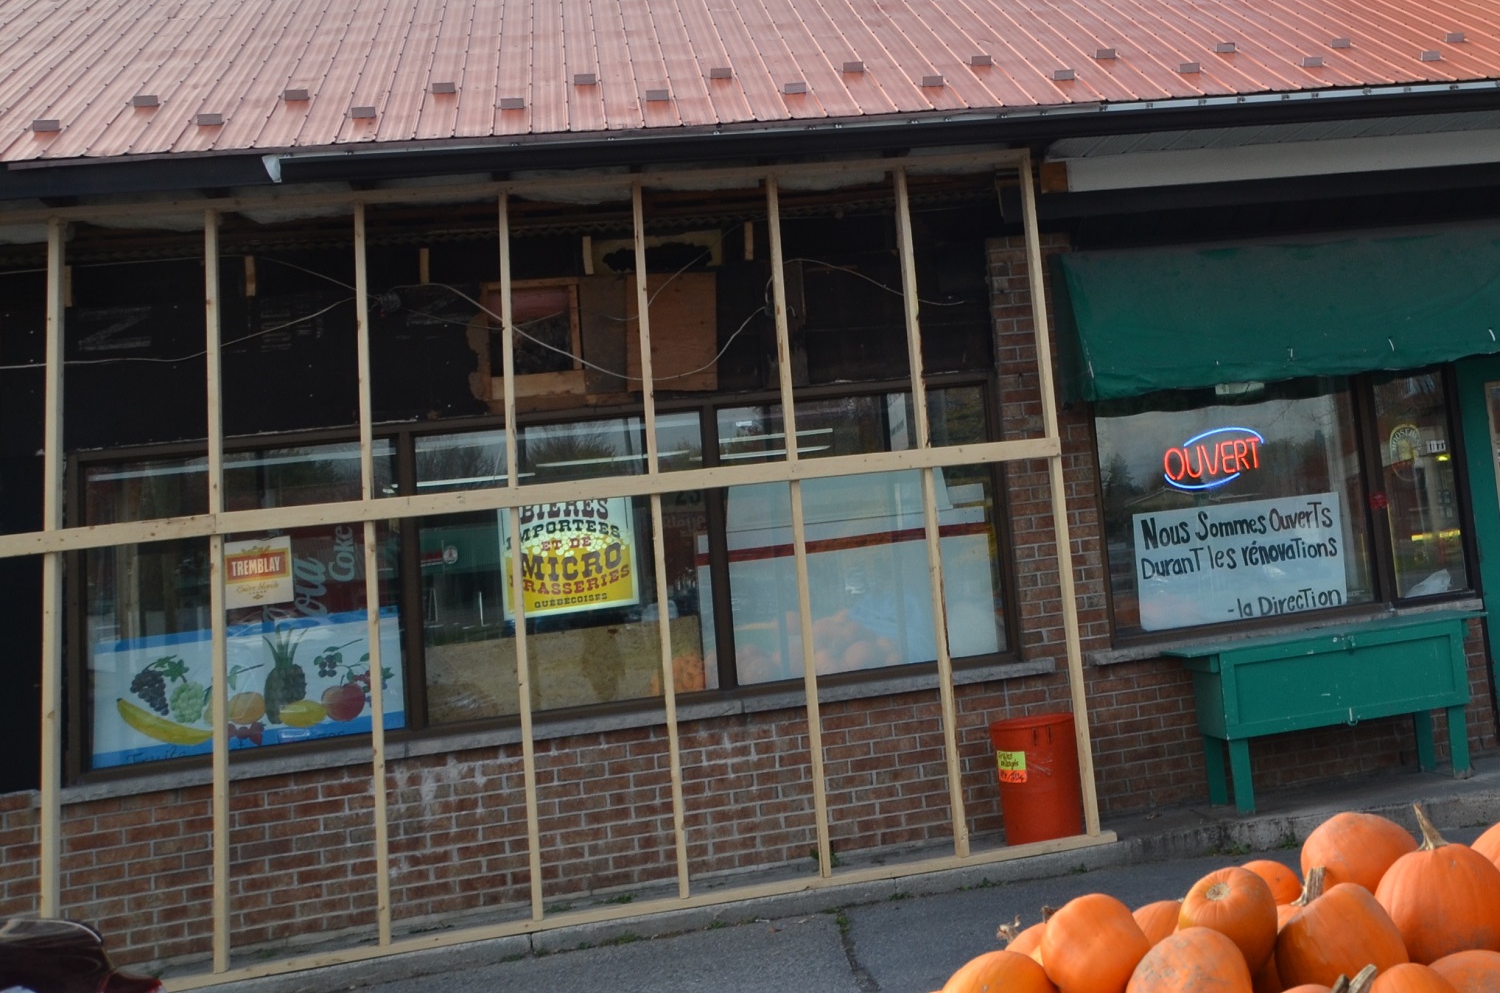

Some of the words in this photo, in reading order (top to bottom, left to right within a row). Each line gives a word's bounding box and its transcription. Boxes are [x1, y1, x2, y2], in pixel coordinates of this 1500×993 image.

[1164, 437, 1260, 481] OUVERT
[541, 539, 562, 551] ET
[569, 536, 592, 548] DE
[1140, 517, 1190, 550] Nous
[1195, 511, 1266, 541] Sommes
[231, 556, 280, 576] TREMBLAY
[521, 542, 622, 581] MICRO
[1207, 545, 1237, 569] les
[510, 564, 630, 595] RASSERIES
